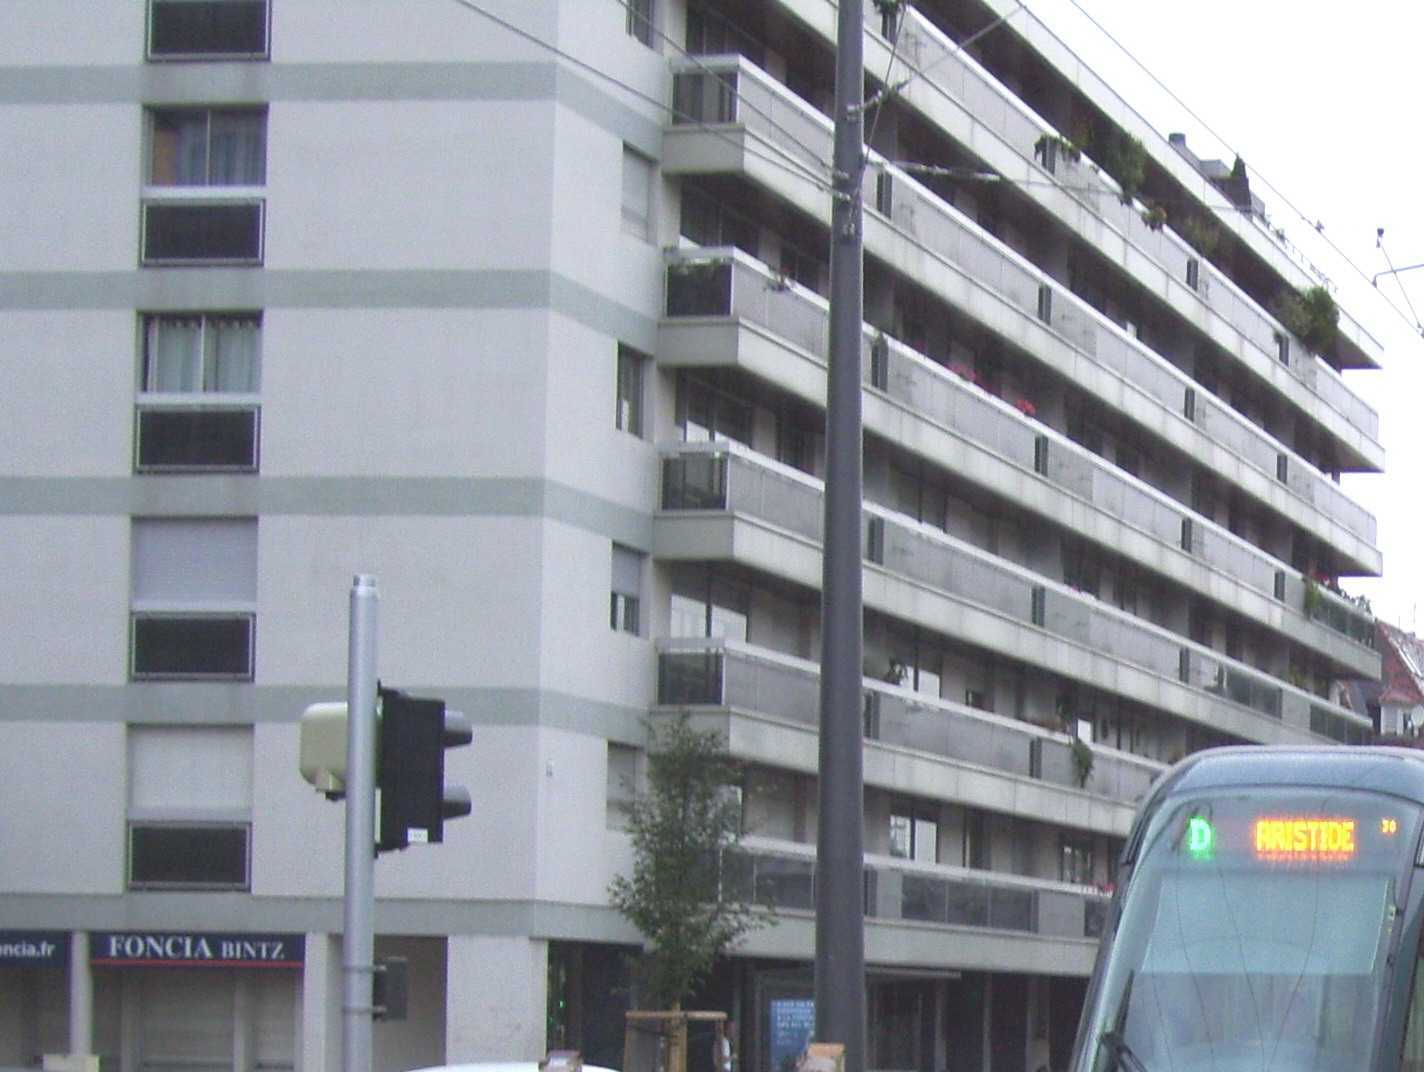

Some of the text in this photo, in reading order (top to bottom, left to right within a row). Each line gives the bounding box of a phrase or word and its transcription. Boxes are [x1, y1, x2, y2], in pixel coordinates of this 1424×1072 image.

[1190, 817, 1212, 851] D
[1256, 819, 1355, 852] ARISTIDE
[0, 940, 56, 957] ncia.fr
[109, 935, 285, 959] FONCIA BINTZ
